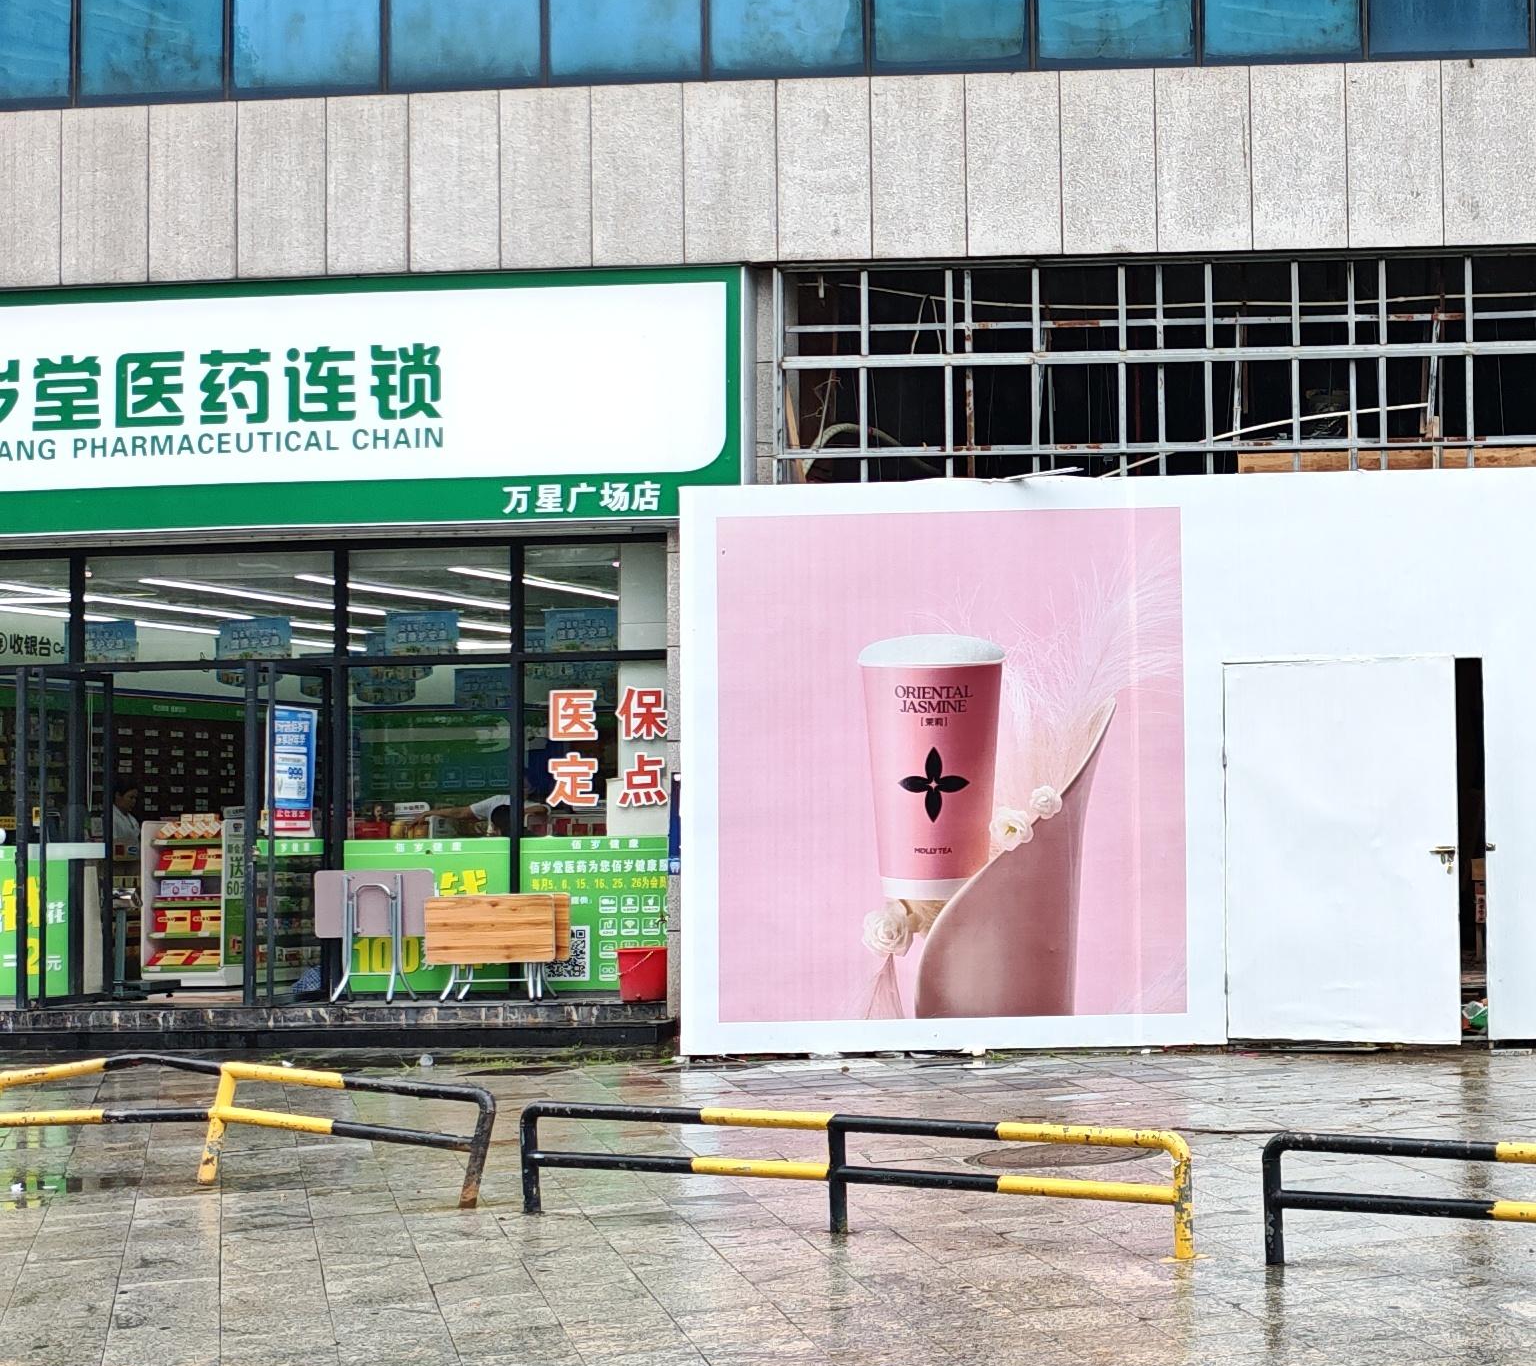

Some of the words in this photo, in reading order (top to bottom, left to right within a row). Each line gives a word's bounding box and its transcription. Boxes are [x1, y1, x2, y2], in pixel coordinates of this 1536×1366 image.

[72, 431, 340, 459] PHARMACEUTICAL
[352, 427, 444, 451] CHAIN
[502, 480, 661, 514] 万星广场店
[9, 634, 51, 656] 收银台
[894, 685, 974, 700] ORIENTAL
[900, 700, 968, 714] JASMINE
[938, 847, 952, 855] TEA
